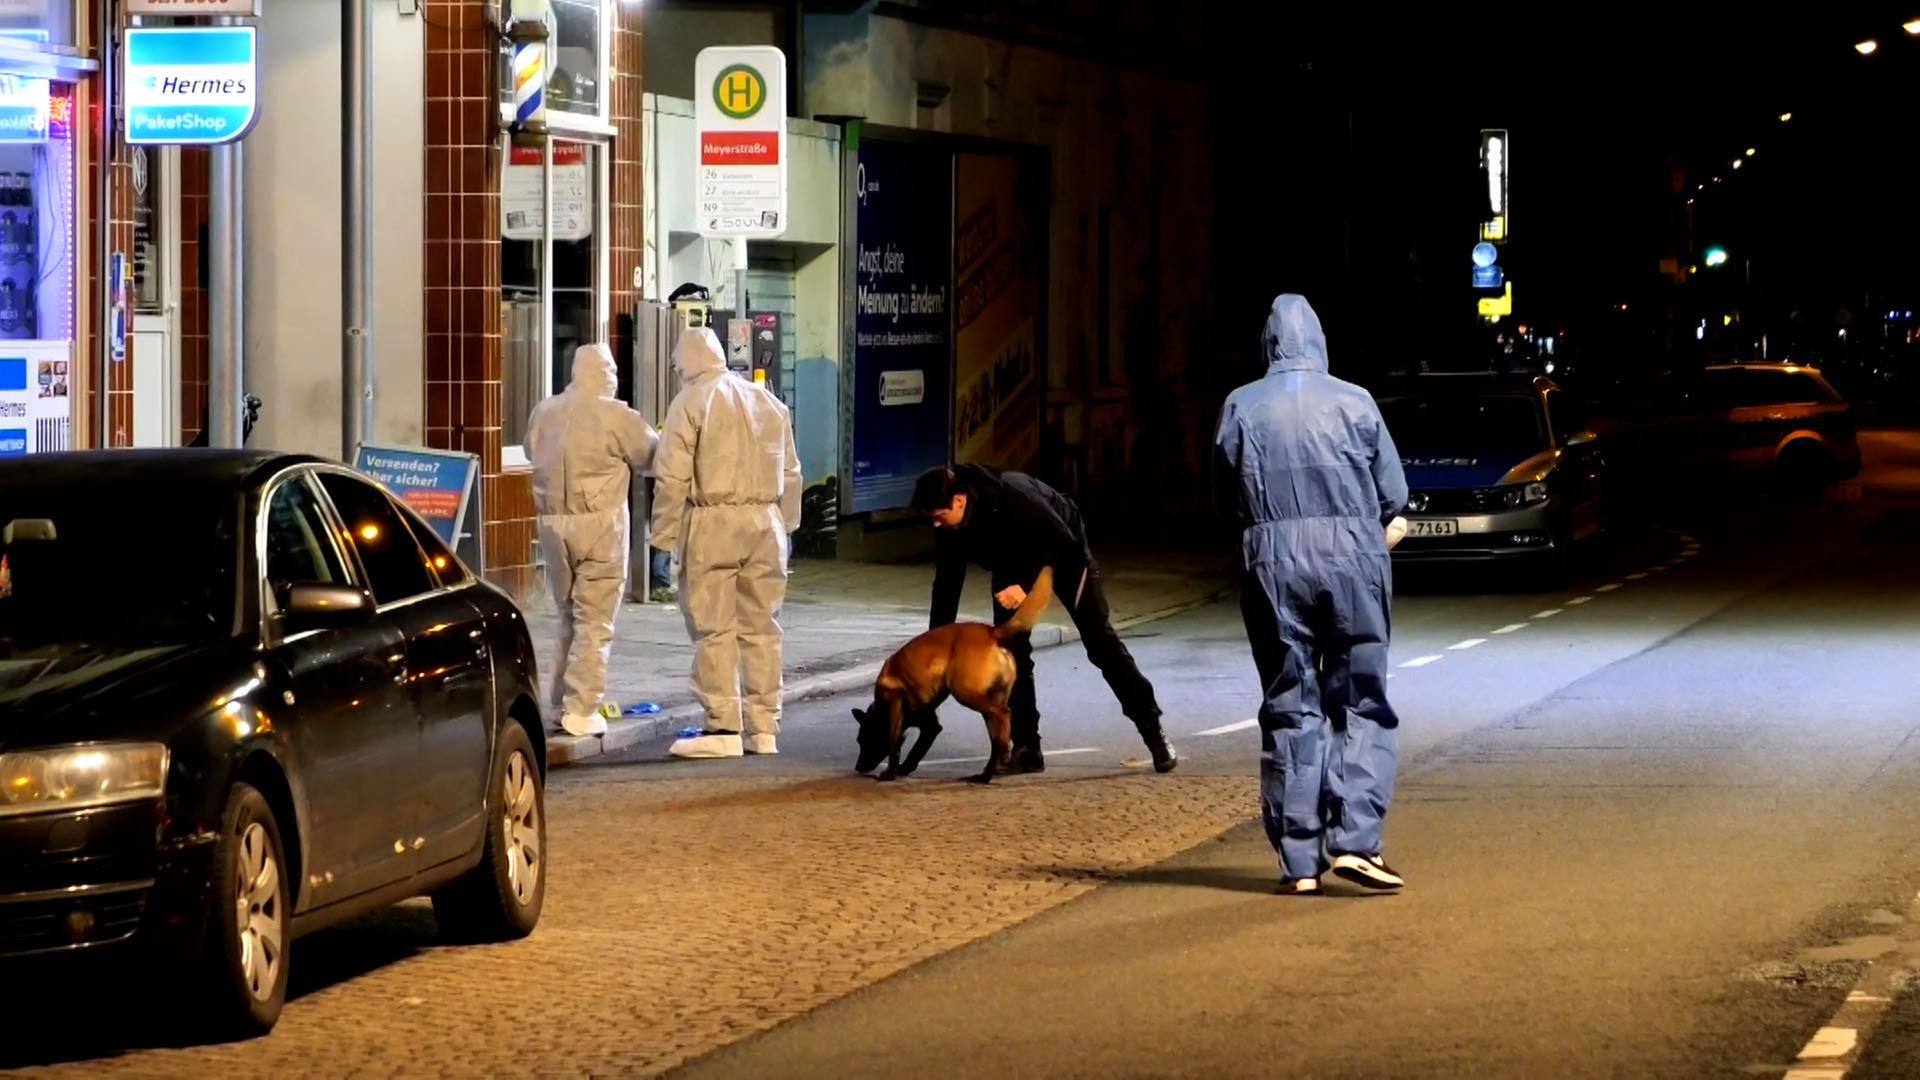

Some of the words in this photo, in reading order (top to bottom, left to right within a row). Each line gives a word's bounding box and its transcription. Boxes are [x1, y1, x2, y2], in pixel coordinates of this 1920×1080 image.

[162, 76, 246, 94] Hermes
[728, 77, 751, 107] H
[134, 112, 227, 131] PaketShop
[703, 143, 768, 157] Meyerstraße
[704, 169, 718, 180] 26
[704, 186, 718, 196] 27
[703, 203, 719, 213] N9
[858, 243, 883, 282] Angst,
[884, 243, 905, 274] deine
[858, 283, 899, 323] Meinung
[900, 293, 910, 314] zu
[911, 283, 945, 314] ändern?
[366, 455, 440, 473] Versenden?
[1399, 458, 1478, 466] OLIZEI
[395, 472, 438, 487] sicher!
[1416, 522, 1452, 534] 7161
